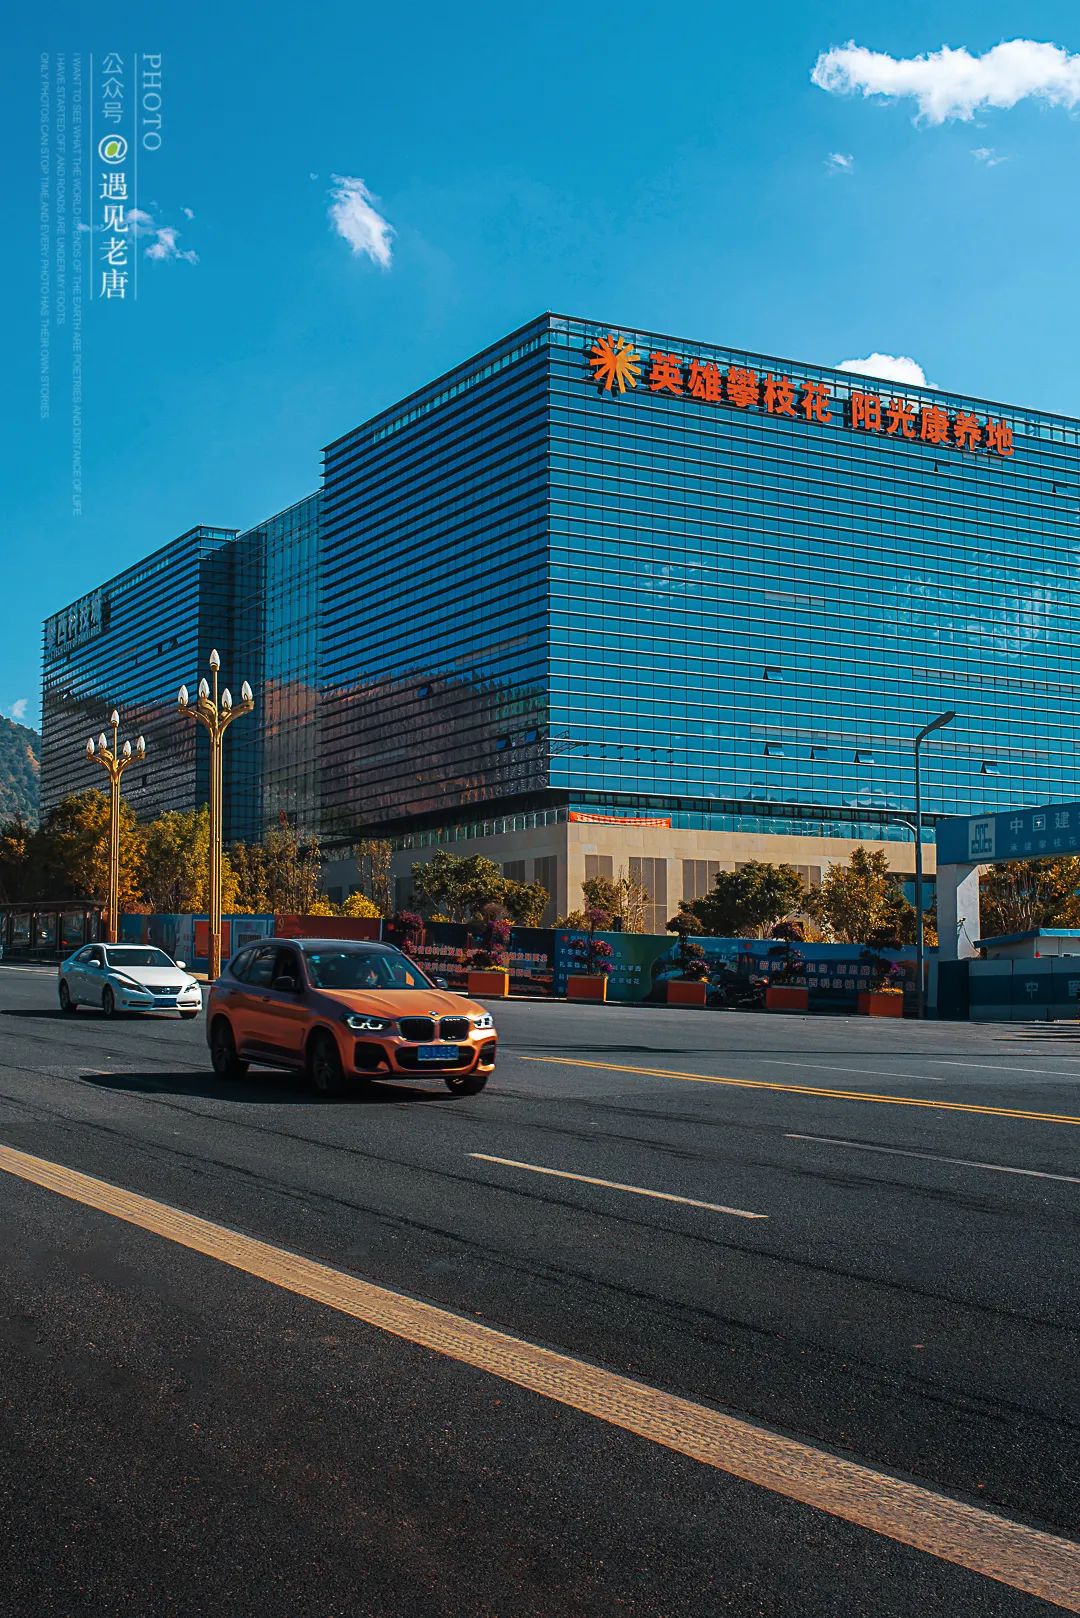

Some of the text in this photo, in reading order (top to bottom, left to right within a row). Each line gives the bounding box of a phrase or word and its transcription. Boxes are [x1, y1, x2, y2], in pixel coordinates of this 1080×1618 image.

[648, 350, 1015, 458] 英雄攀枝花 阳光康养地
[1010, 811, 1080, 835] 中国建
